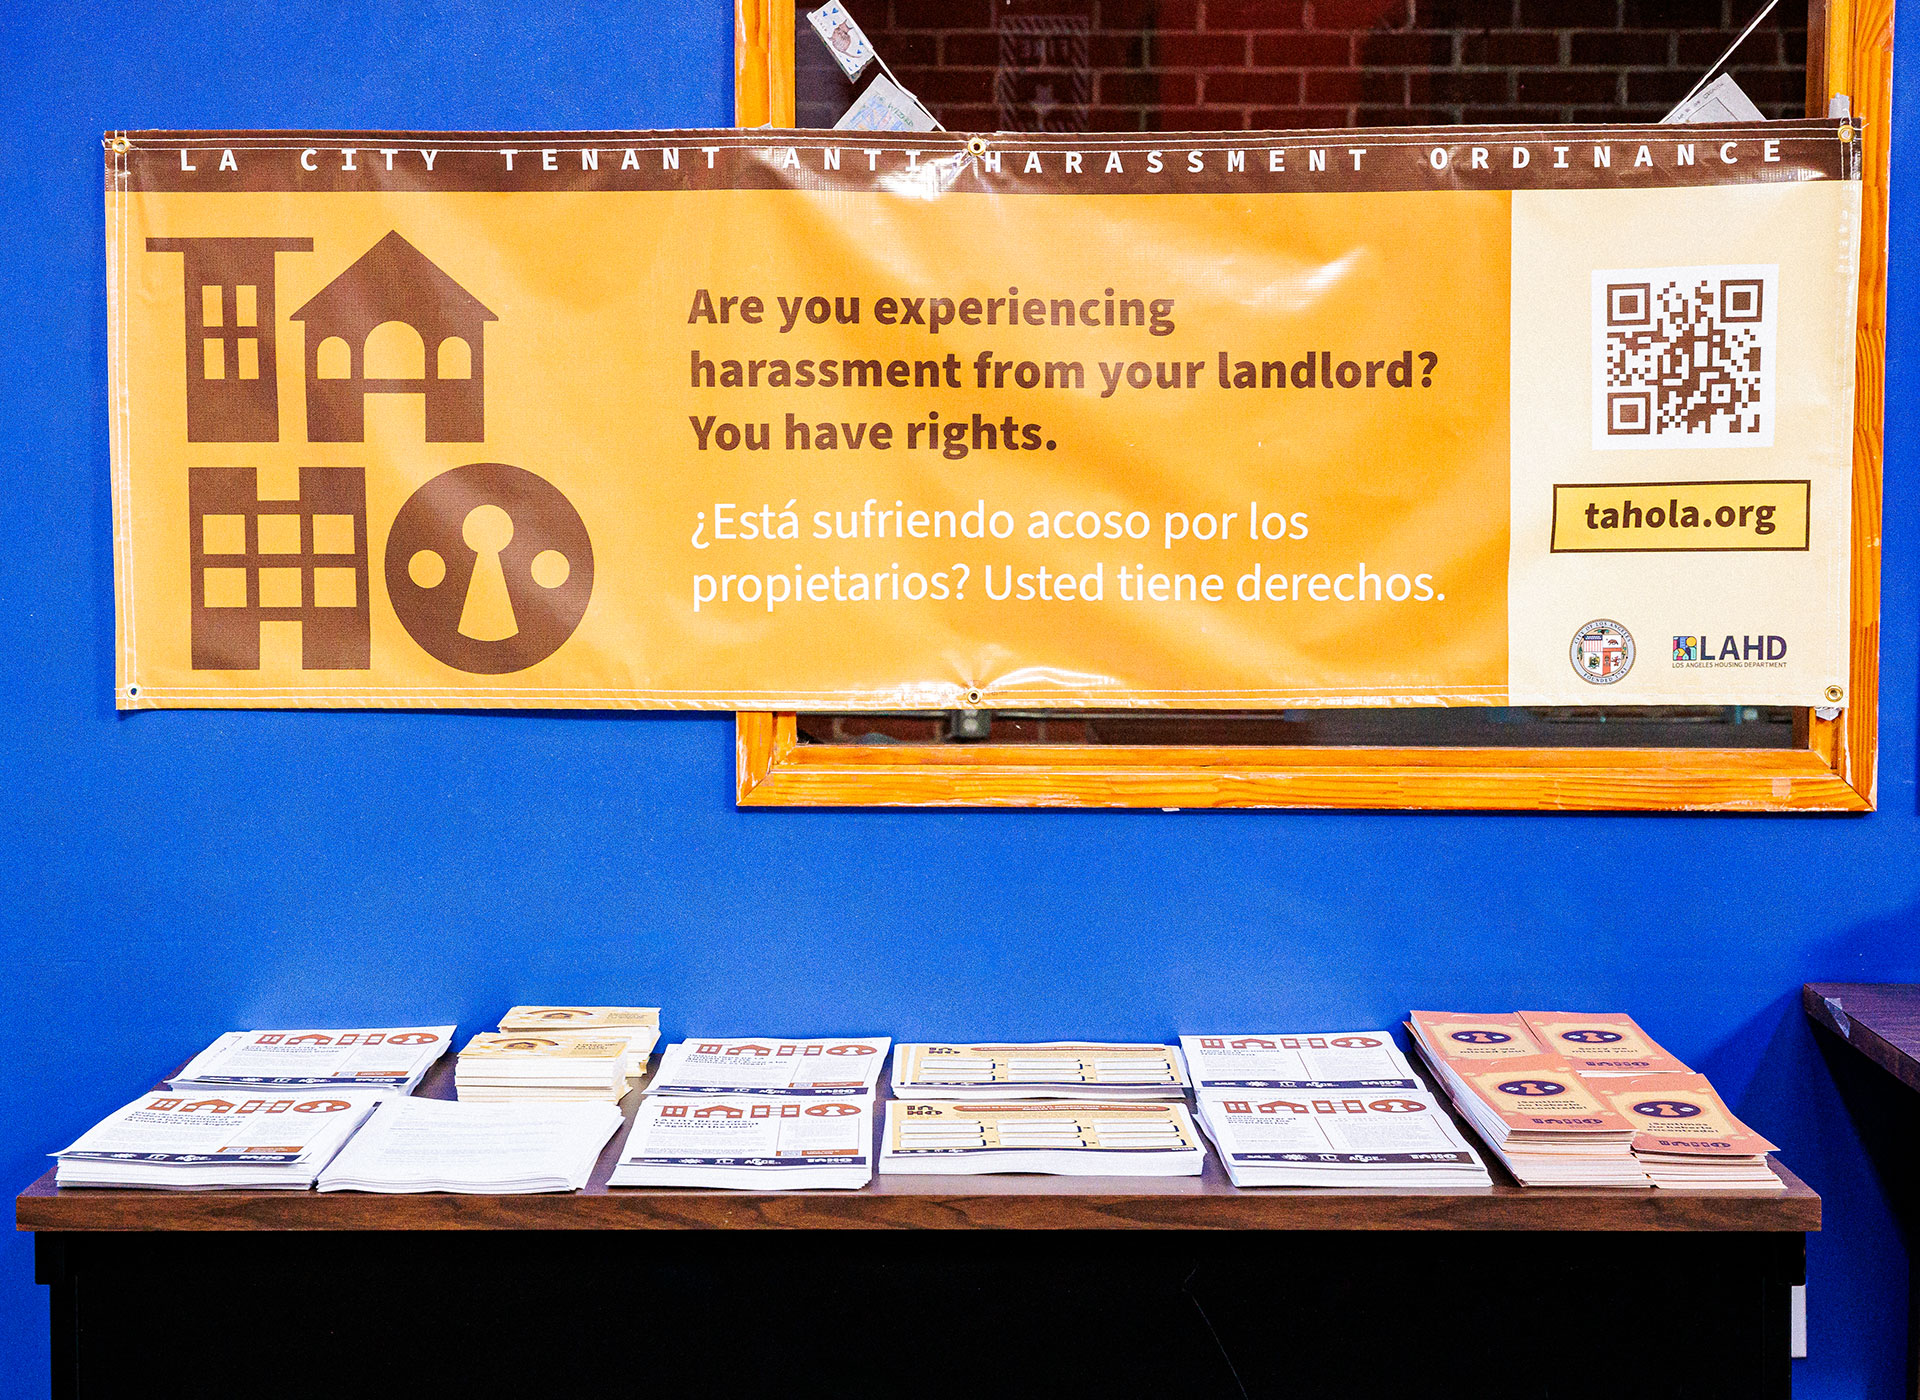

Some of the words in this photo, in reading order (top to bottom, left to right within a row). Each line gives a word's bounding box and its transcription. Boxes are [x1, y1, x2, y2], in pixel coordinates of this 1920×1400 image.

[180, 149, 240, 171] LA
[300, 149, 439, 171] CITY
[501, 147, 721, 171] TENANT
[1430, 140, 1782, 169] ORDINANCE
[688, 289, 764, 324] Are
[778, 296, 860, 333] you
[874, 289, 1175, 336] experiencing
[691, 352, 961, 389] harassment
[974, 350, 1086, 388] from
[1099, 361, 1206, 398] your
[1219, 351, 1438, 389] landlord?
[689, 416, 770, 450] You
[785, 413, 892, 449] have
[907, 410, 1057, 459] rights.
[691, 499, 799, 549] ¿Está
[812, 498, 1015, 539] sufriendo
[1027, 510, 1150, 539] acoso
[1164, 512, 1238, 549] por
[1250, 501, 1309, 540] los
[1584, 499, 1777, 535] tahola.org
[692, 562, 970, 613] propietarios?
[985, 562, 1104, 602] Usted
[1116, 563, 1224, 602] tiene
[1236, 562, 1446, 602] derechos.
[1700, 635, 1787, 661] LAHD
